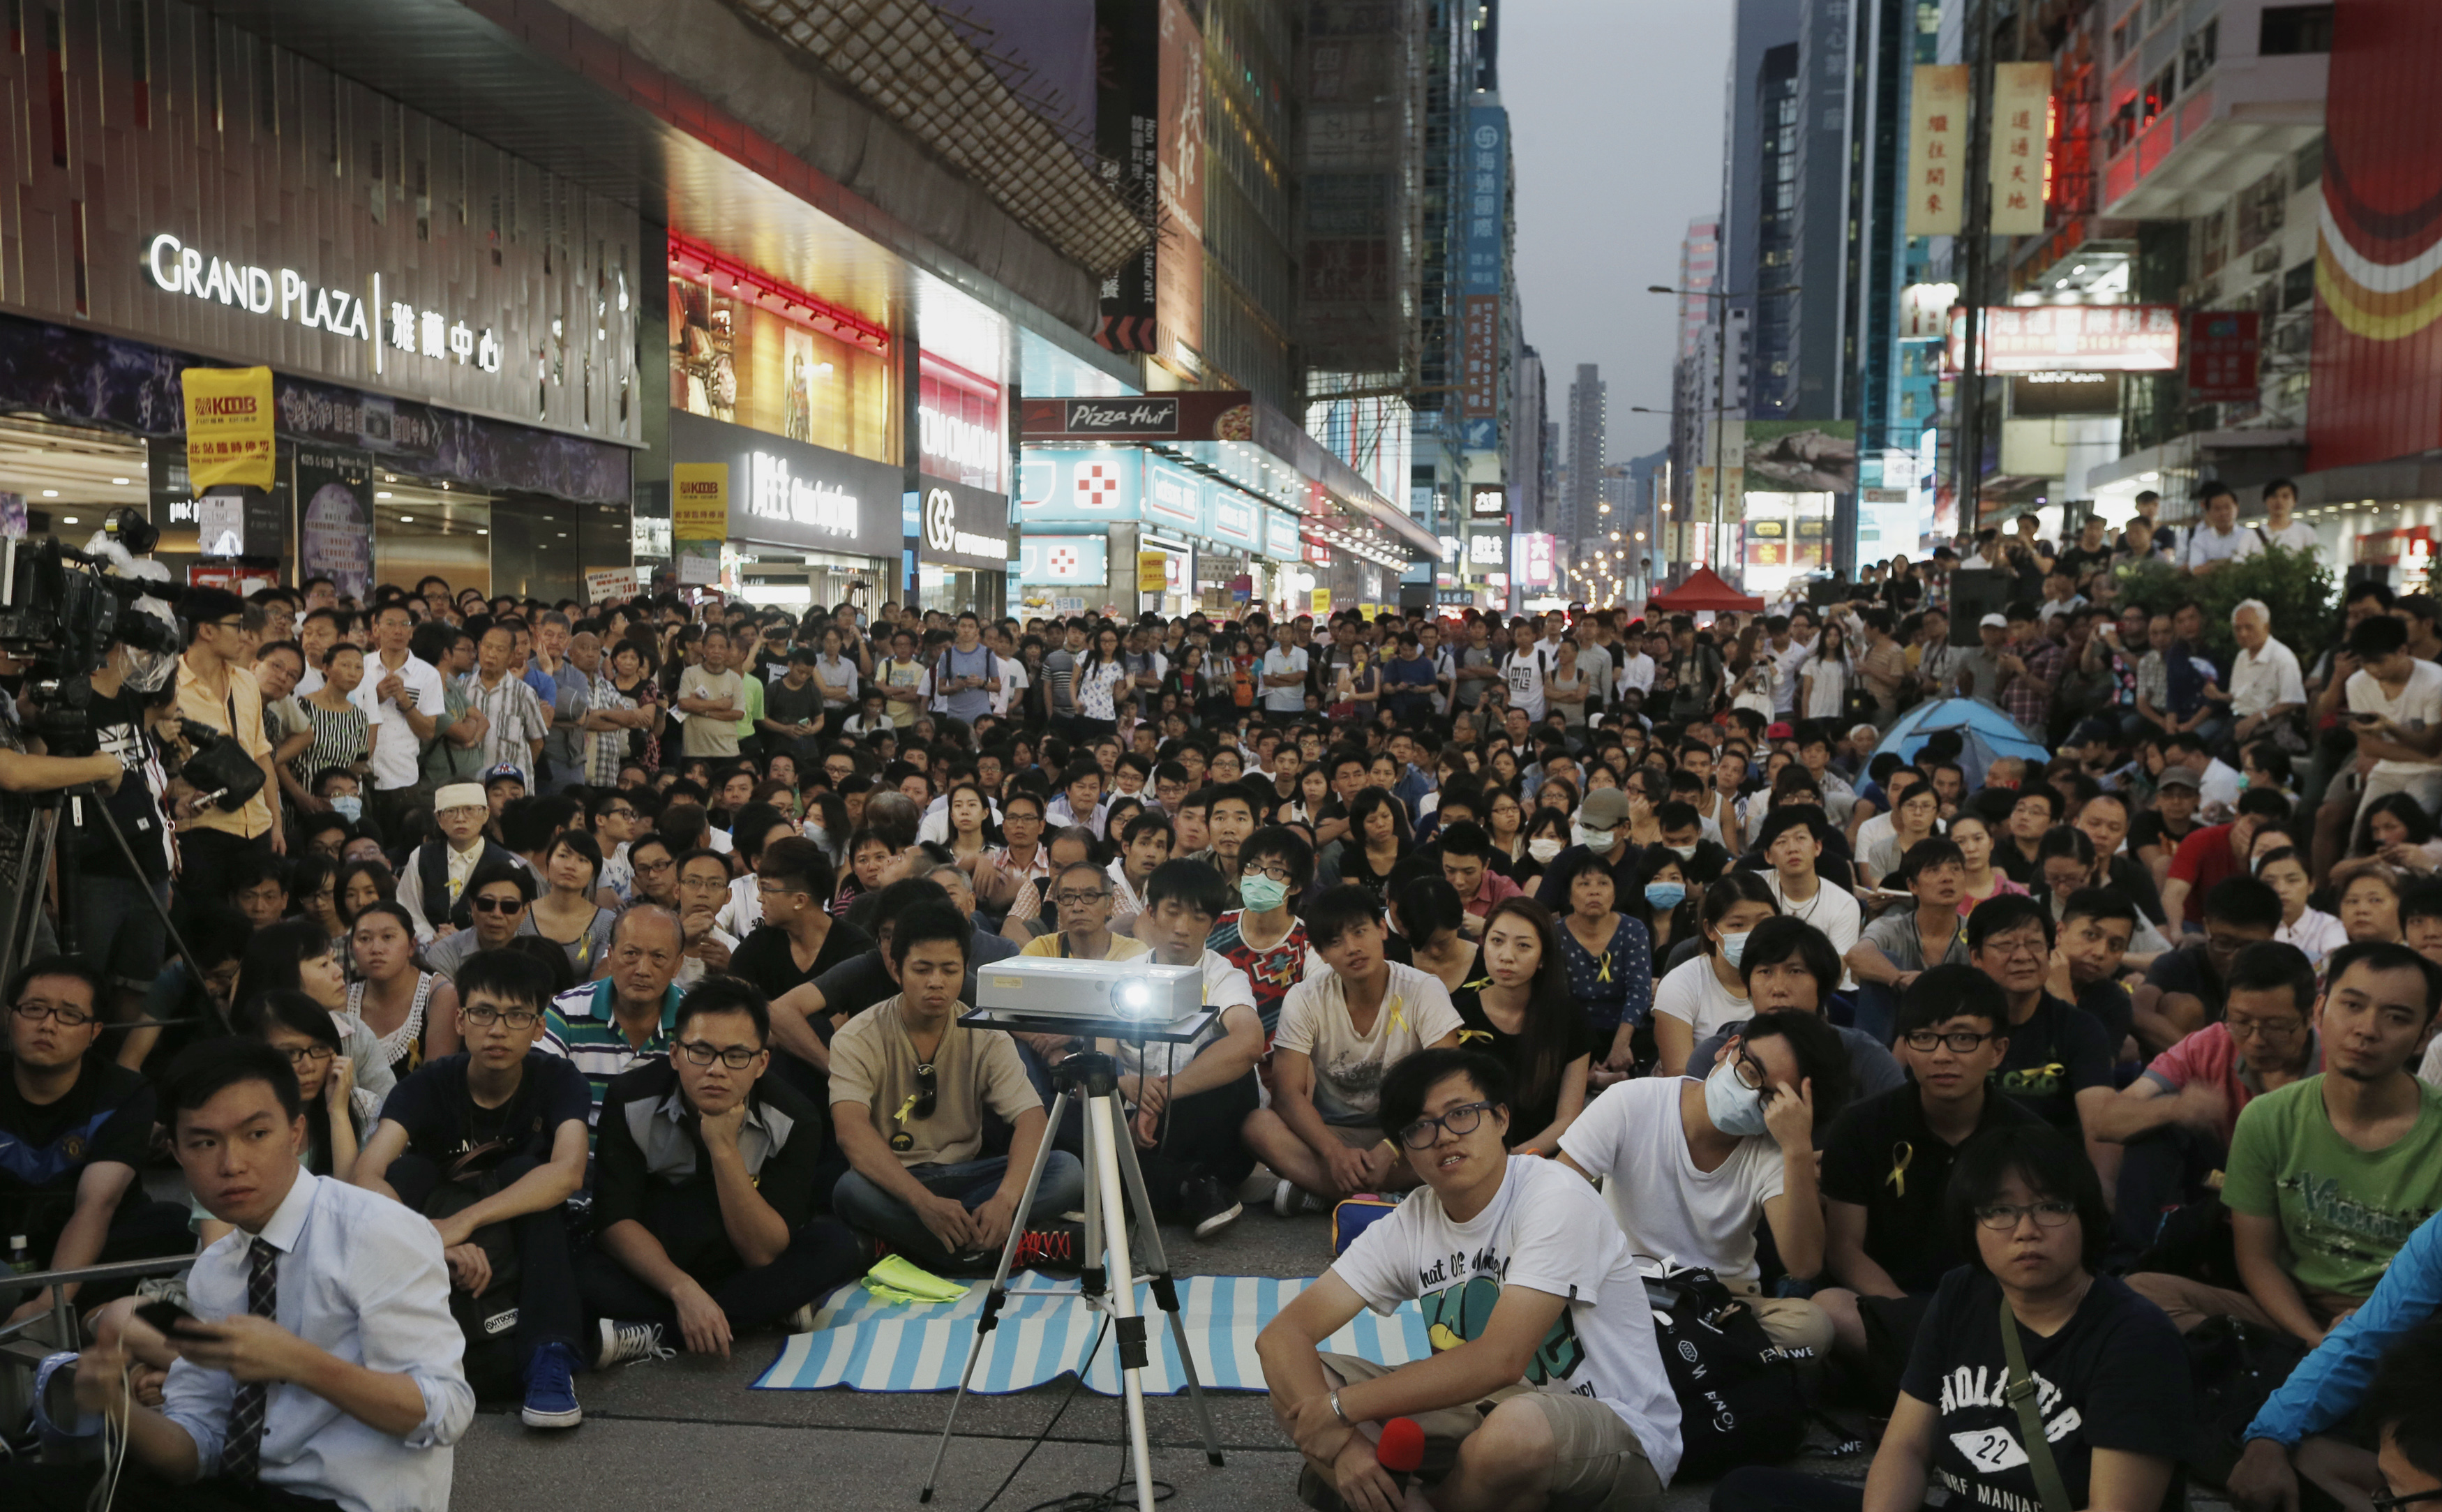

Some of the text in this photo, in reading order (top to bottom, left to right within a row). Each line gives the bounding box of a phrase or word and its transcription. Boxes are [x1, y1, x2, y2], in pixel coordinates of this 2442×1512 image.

[1145, 119, 1156, 143] Hon
[151, 234, 368, 340] GRAND PLAZA
[391, 301, 500, 373] 雅蘭中心
[213, 396, 257, 414] KMB
[1070, 404, 1174, 428] Pizza Hut
[190, 440, 269, 454] 此站臨時停用
[1789, 1346, 1814, 1358] WE
[1976, 1435, 2009, 1465] 22
